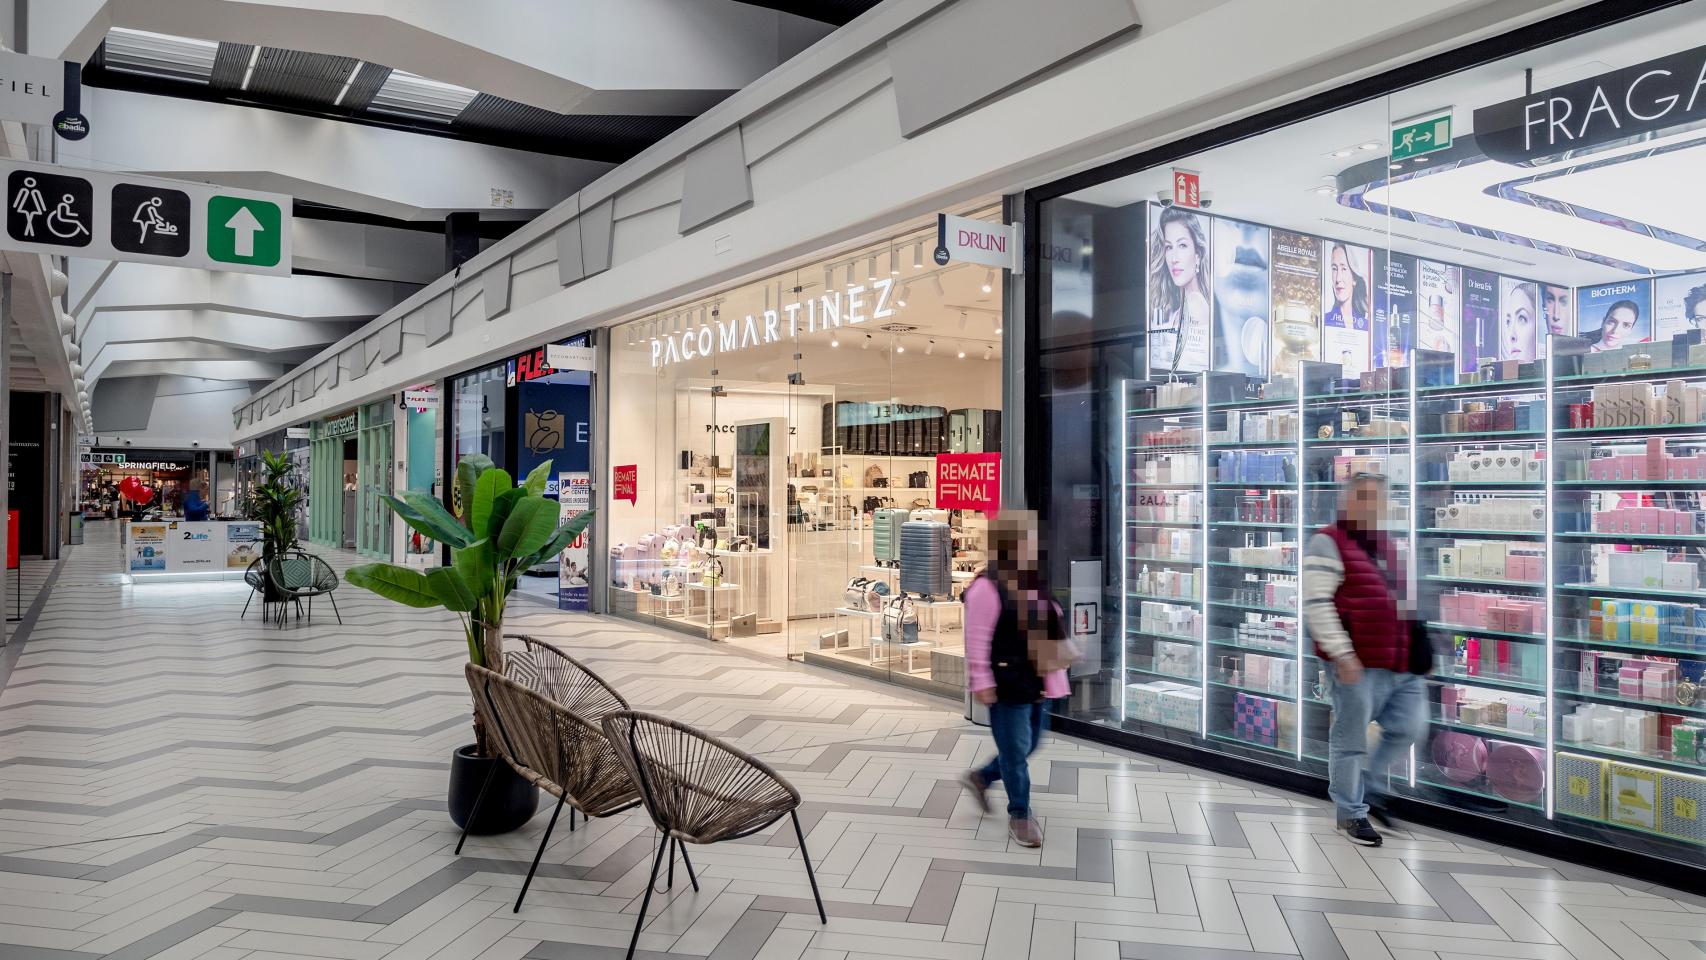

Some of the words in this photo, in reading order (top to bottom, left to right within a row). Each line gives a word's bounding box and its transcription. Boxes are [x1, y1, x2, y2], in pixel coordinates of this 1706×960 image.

[959, 230, 1006, 253] DRUNI
[1591, 285, 1636, 298] BIOTHERM
[516, 351, 554, 383] FLE
[118, 462, 177, 470] SPRINGFIELD
[940, 462, 996, 481] REMATE
[615, 471, 636, 482] REMATE
[940, 483, 992, 502] FINAL
